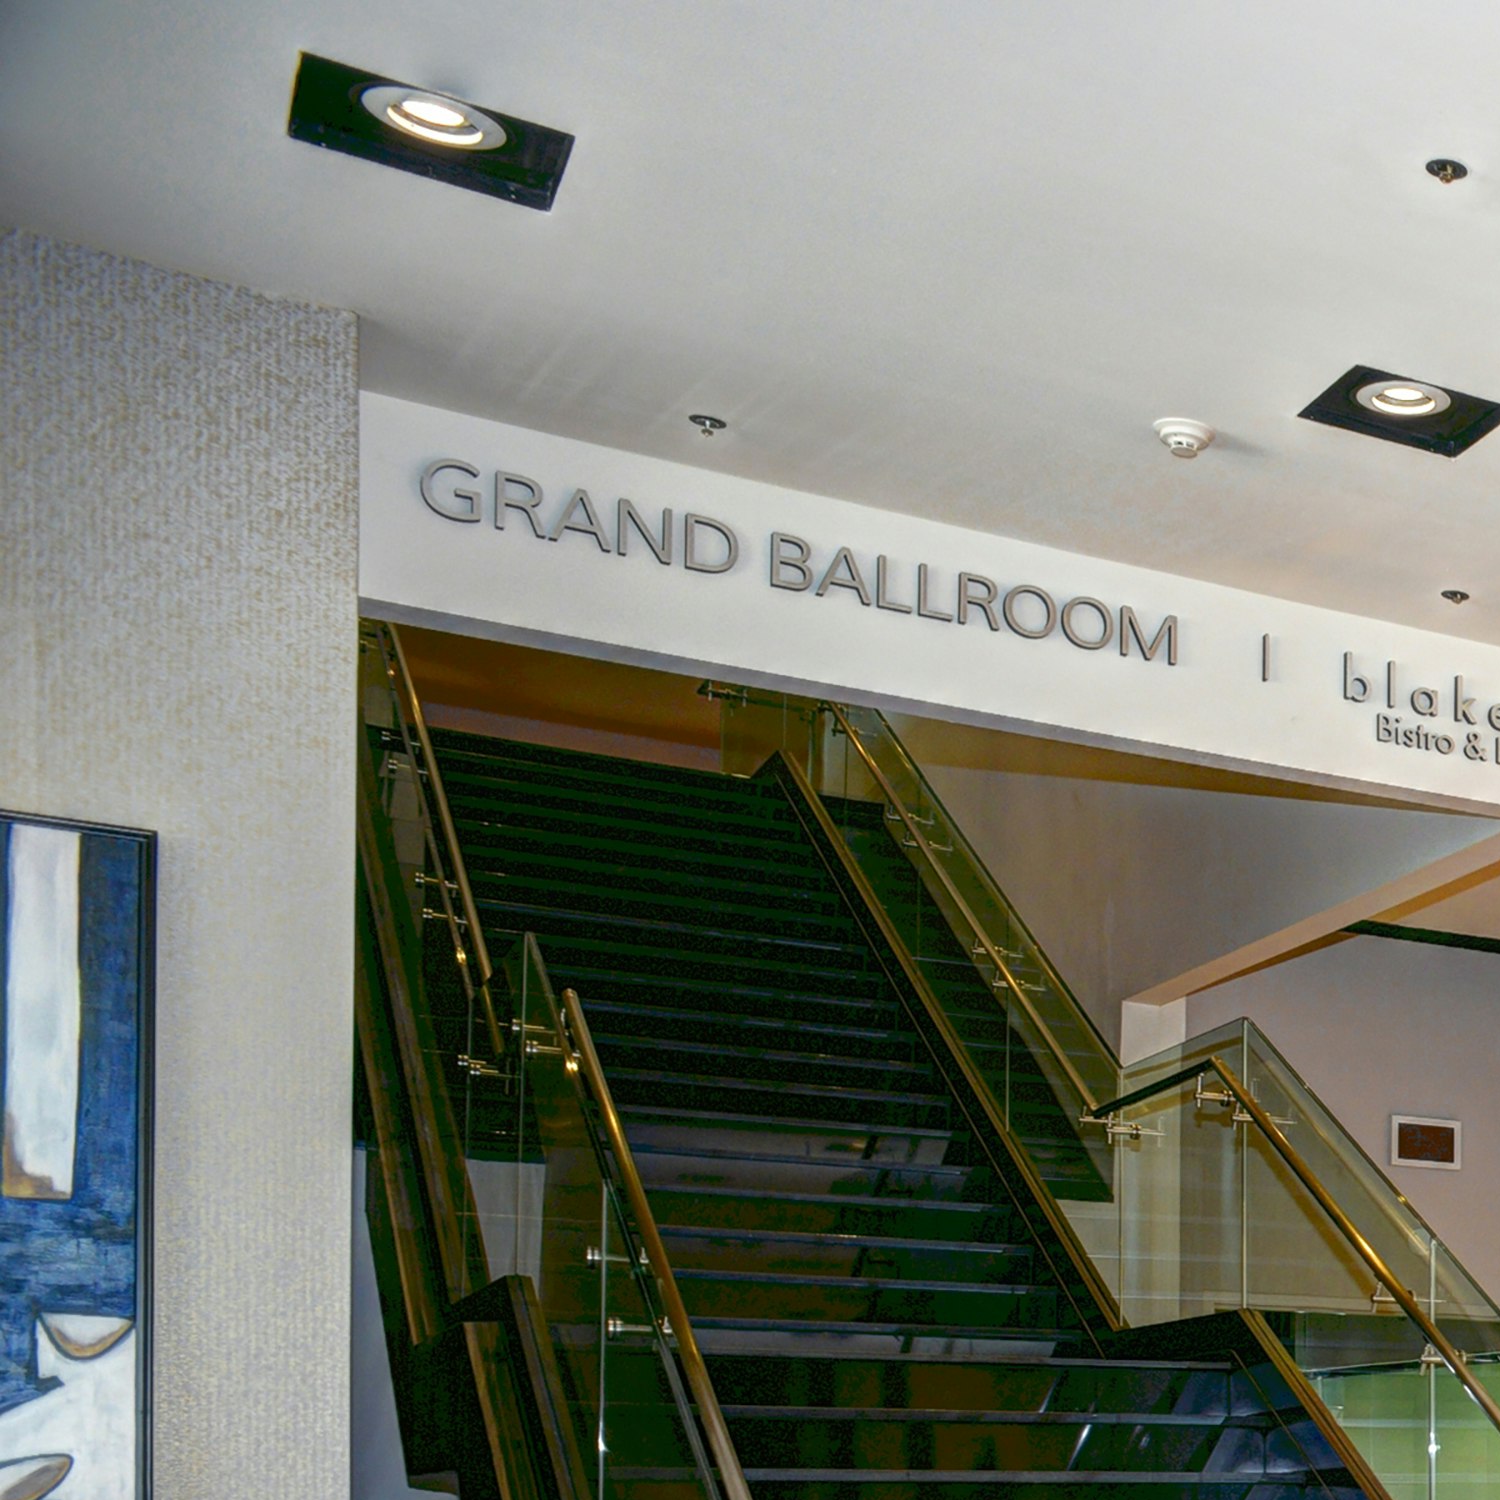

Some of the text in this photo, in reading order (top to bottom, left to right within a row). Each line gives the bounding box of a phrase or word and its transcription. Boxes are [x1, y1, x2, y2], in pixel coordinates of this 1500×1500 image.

[419, 457, 740, 574] GRAND
[769, 530, 1179, 667] BALLROOM
[1376, 712, 1456, 756] Bistro
[1463, 732, 1487, 762] &
